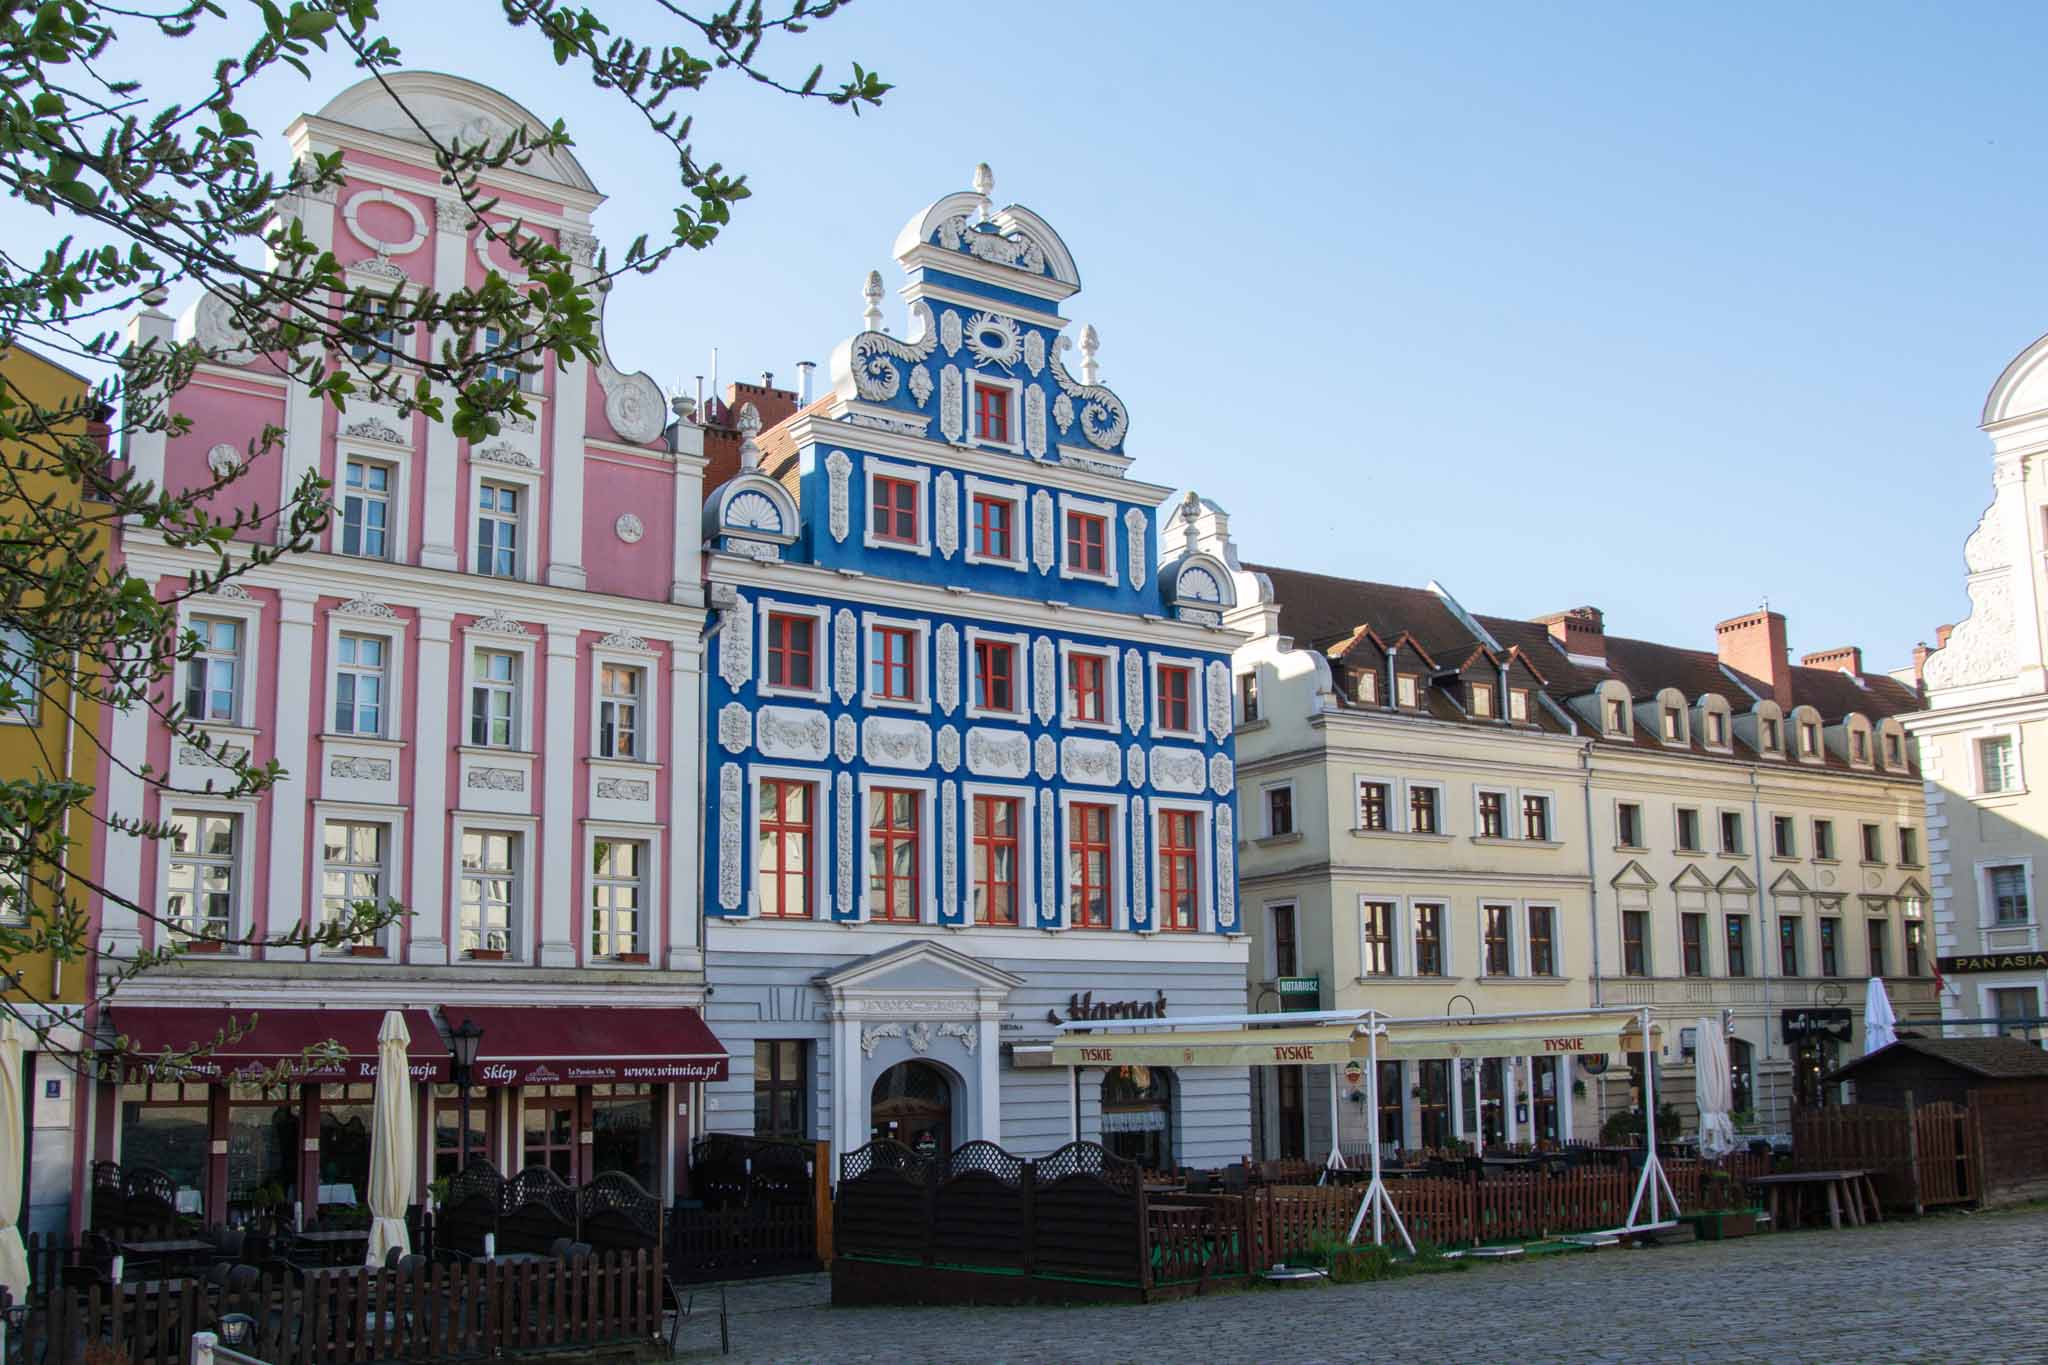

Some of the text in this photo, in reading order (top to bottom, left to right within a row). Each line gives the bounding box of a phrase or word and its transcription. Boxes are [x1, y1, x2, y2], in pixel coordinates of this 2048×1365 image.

[1956, 954, 2048, 969] PAN ASIA
[1280, 981, 1319, 992] NOTARIUSZ
[1544, 1037, 1585, 1051] TYSKIE
[1080, 1048, 1113, 1062] TYSKIE
[1274, 1045, 1314, 1060] TYSKIE
[482, 1064, 517, 1084] Sklep
[623, 1061, 721, 1082] www.winnica.pl
